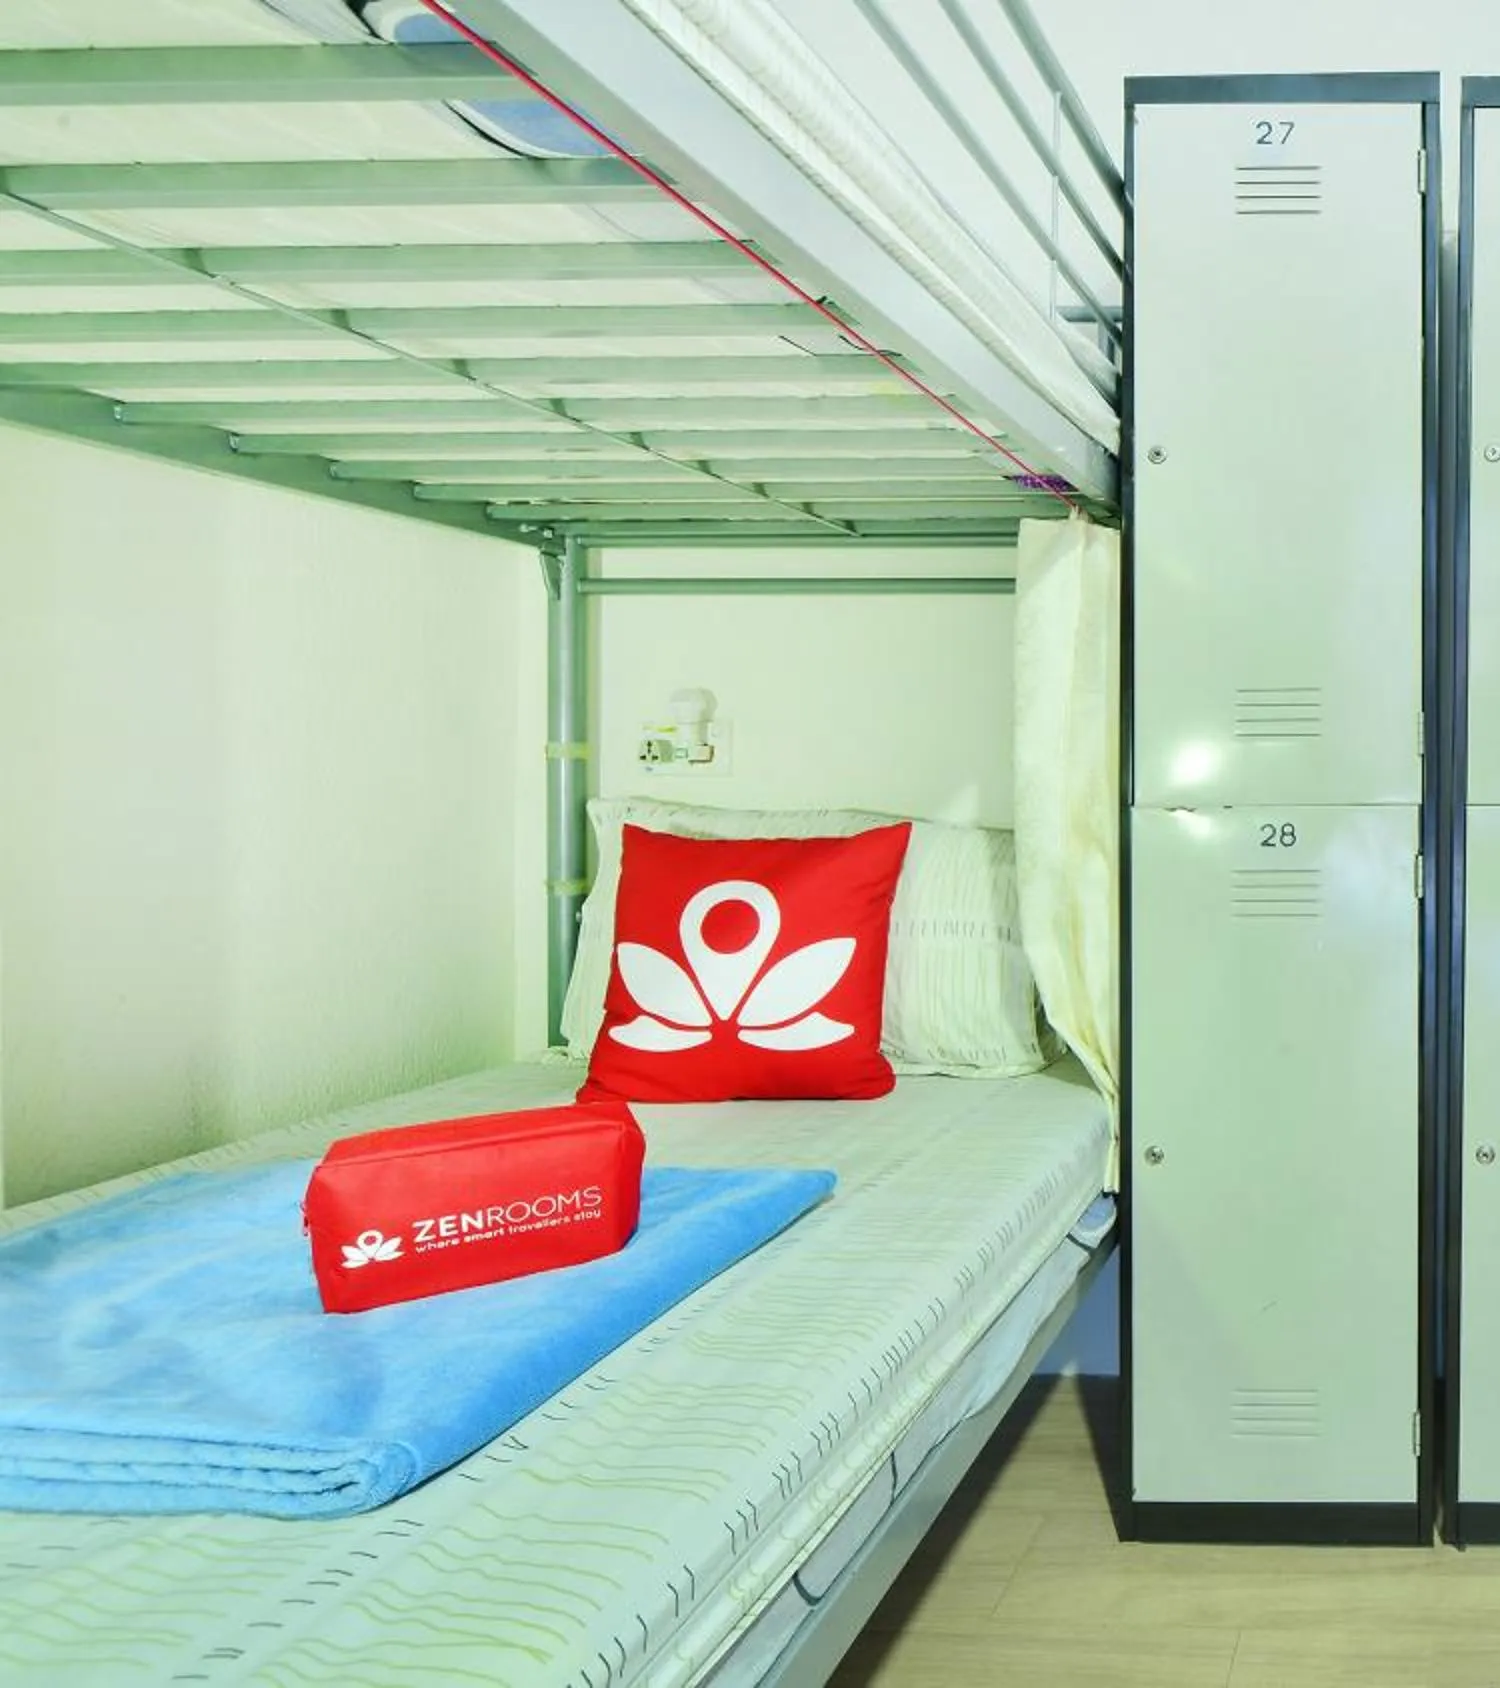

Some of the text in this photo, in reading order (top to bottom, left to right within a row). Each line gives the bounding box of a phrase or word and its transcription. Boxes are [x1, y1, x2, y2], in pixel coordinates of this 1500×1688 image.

[1255, 121, 1295, 145] 27
[1260, 823, 1297, 848] 28
[412, 1186, 603, 1244] ZENROOMS
[415, 1207, 602, 1254] where smart travellers stay
